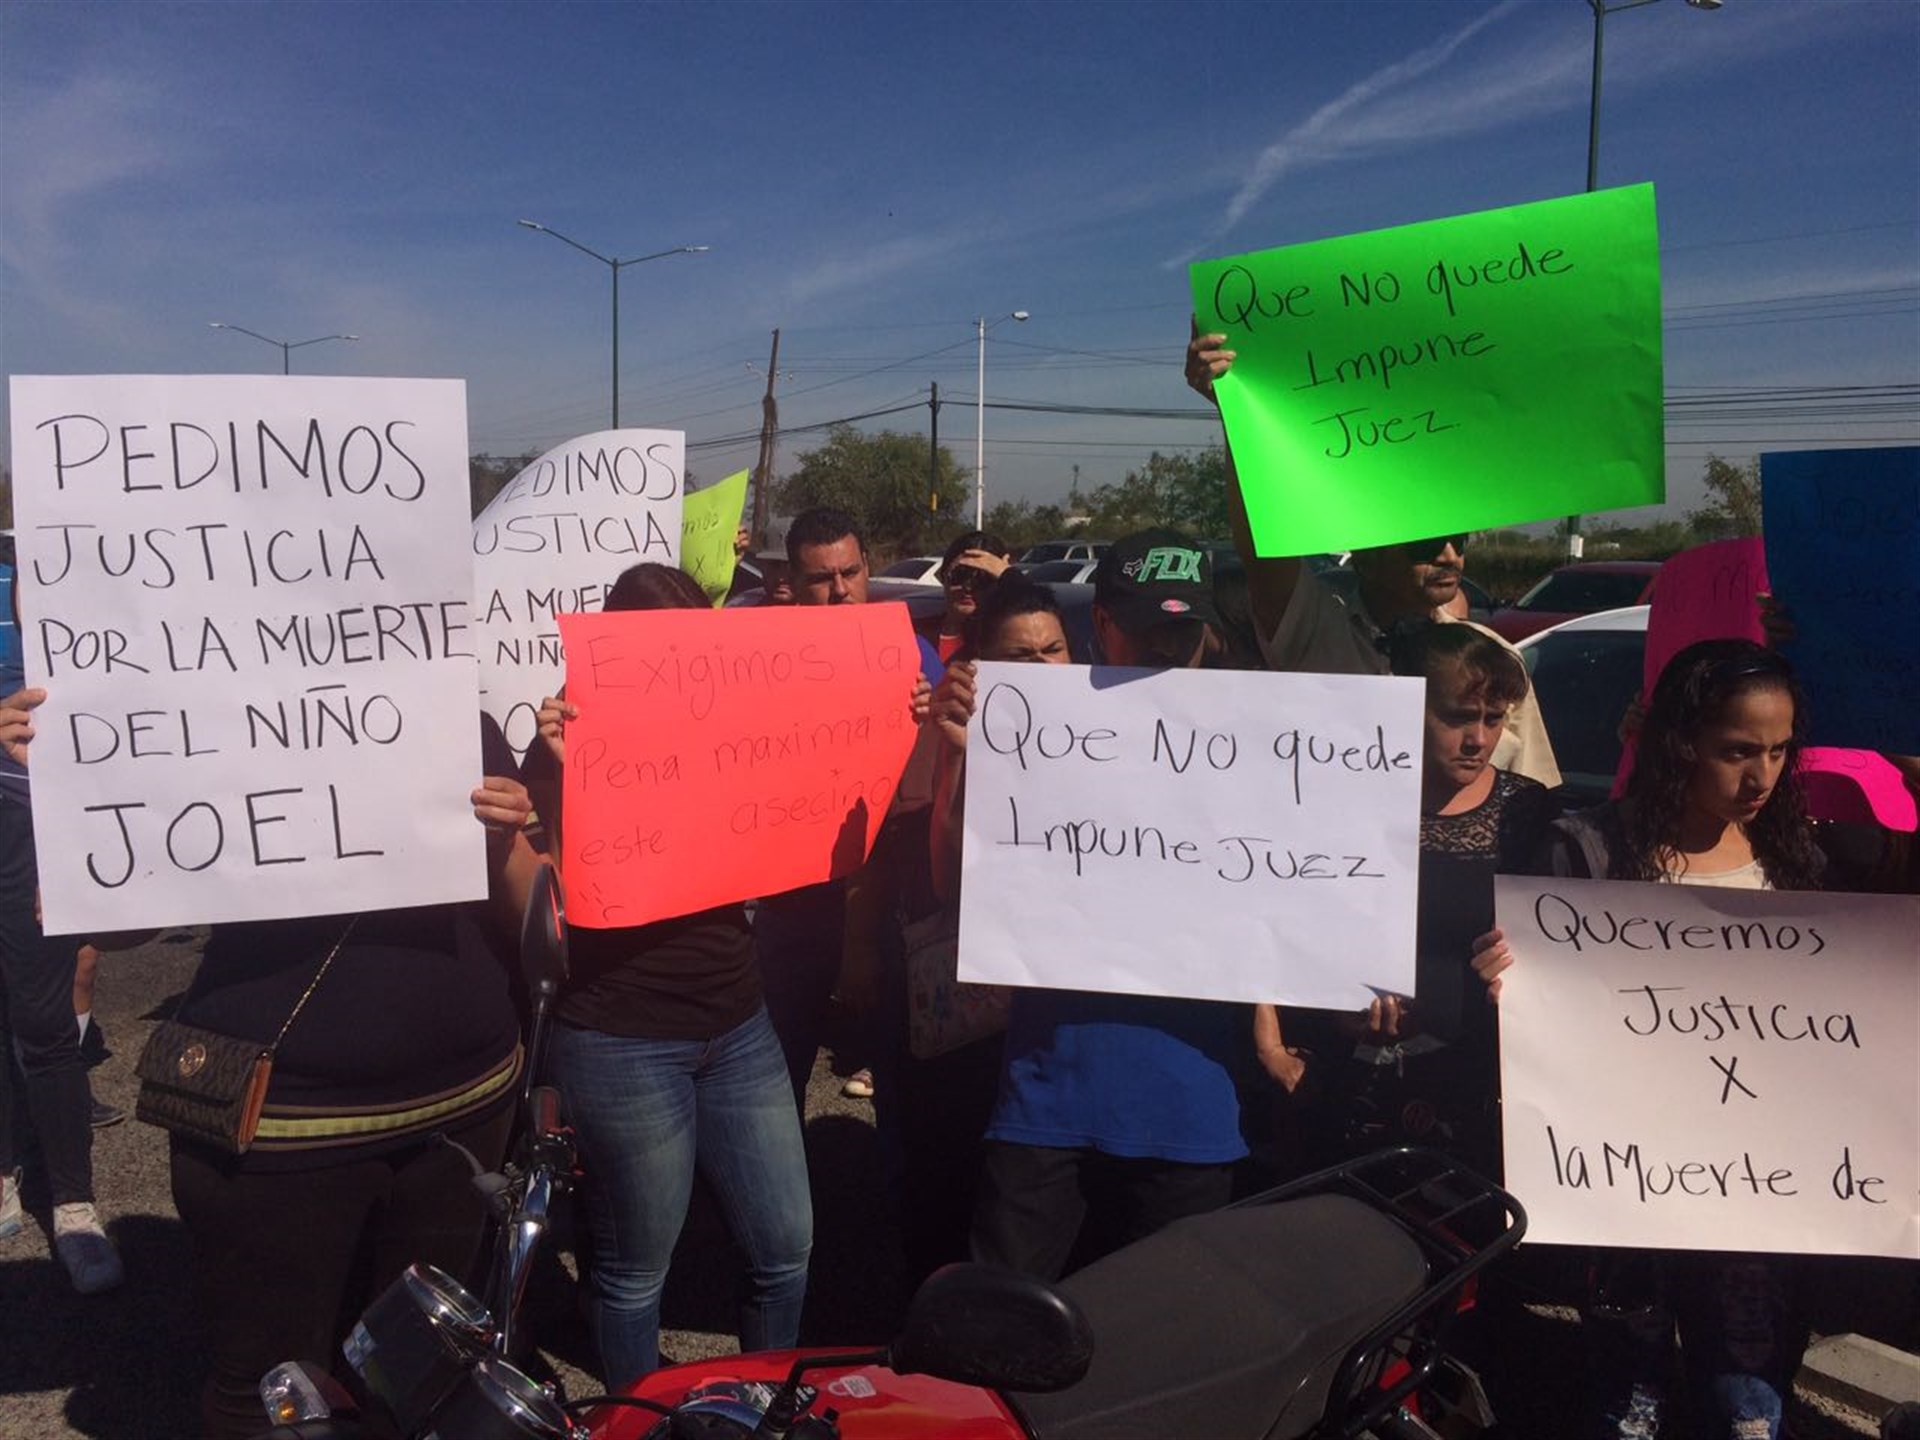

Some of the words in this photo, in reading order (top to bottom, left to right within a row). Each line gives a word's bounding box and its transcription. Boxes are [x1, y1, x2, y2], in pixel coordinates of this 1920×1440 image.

[1214, 264, 1316, 332] Que
[1427, 242, 1574, 317] quede
[36, 414, 425, 502] PEDIMOS
[33, 523, 385, 588] JUSTICIA
[472, 510, 672, 557] USTICIA
[1137, 546, 1202, 583] FOX
[38, 618, 150, 677] POR
[162, 616, 238, 672] LA
[256, 601, 475, 667] MUERTE
[588, 634, 836, 721] Exigimos
[859, 622, 904, 673] la
[70, 709, 219, 764] DEL
[246, 685, 402, 750] NIÑO
[573, 738, 681, 791] Pena
[714, 715, 871, 773] maxima
[982, 683, 1118, 770] Que
[1274, 725, 1413, 804] quede
[84, 784, 385, 888] JOEL
[580, 826, 667, 865] este
[1535, 893, 1825, 955] Queremos
[1832, 1146, 1888, 1204] de
